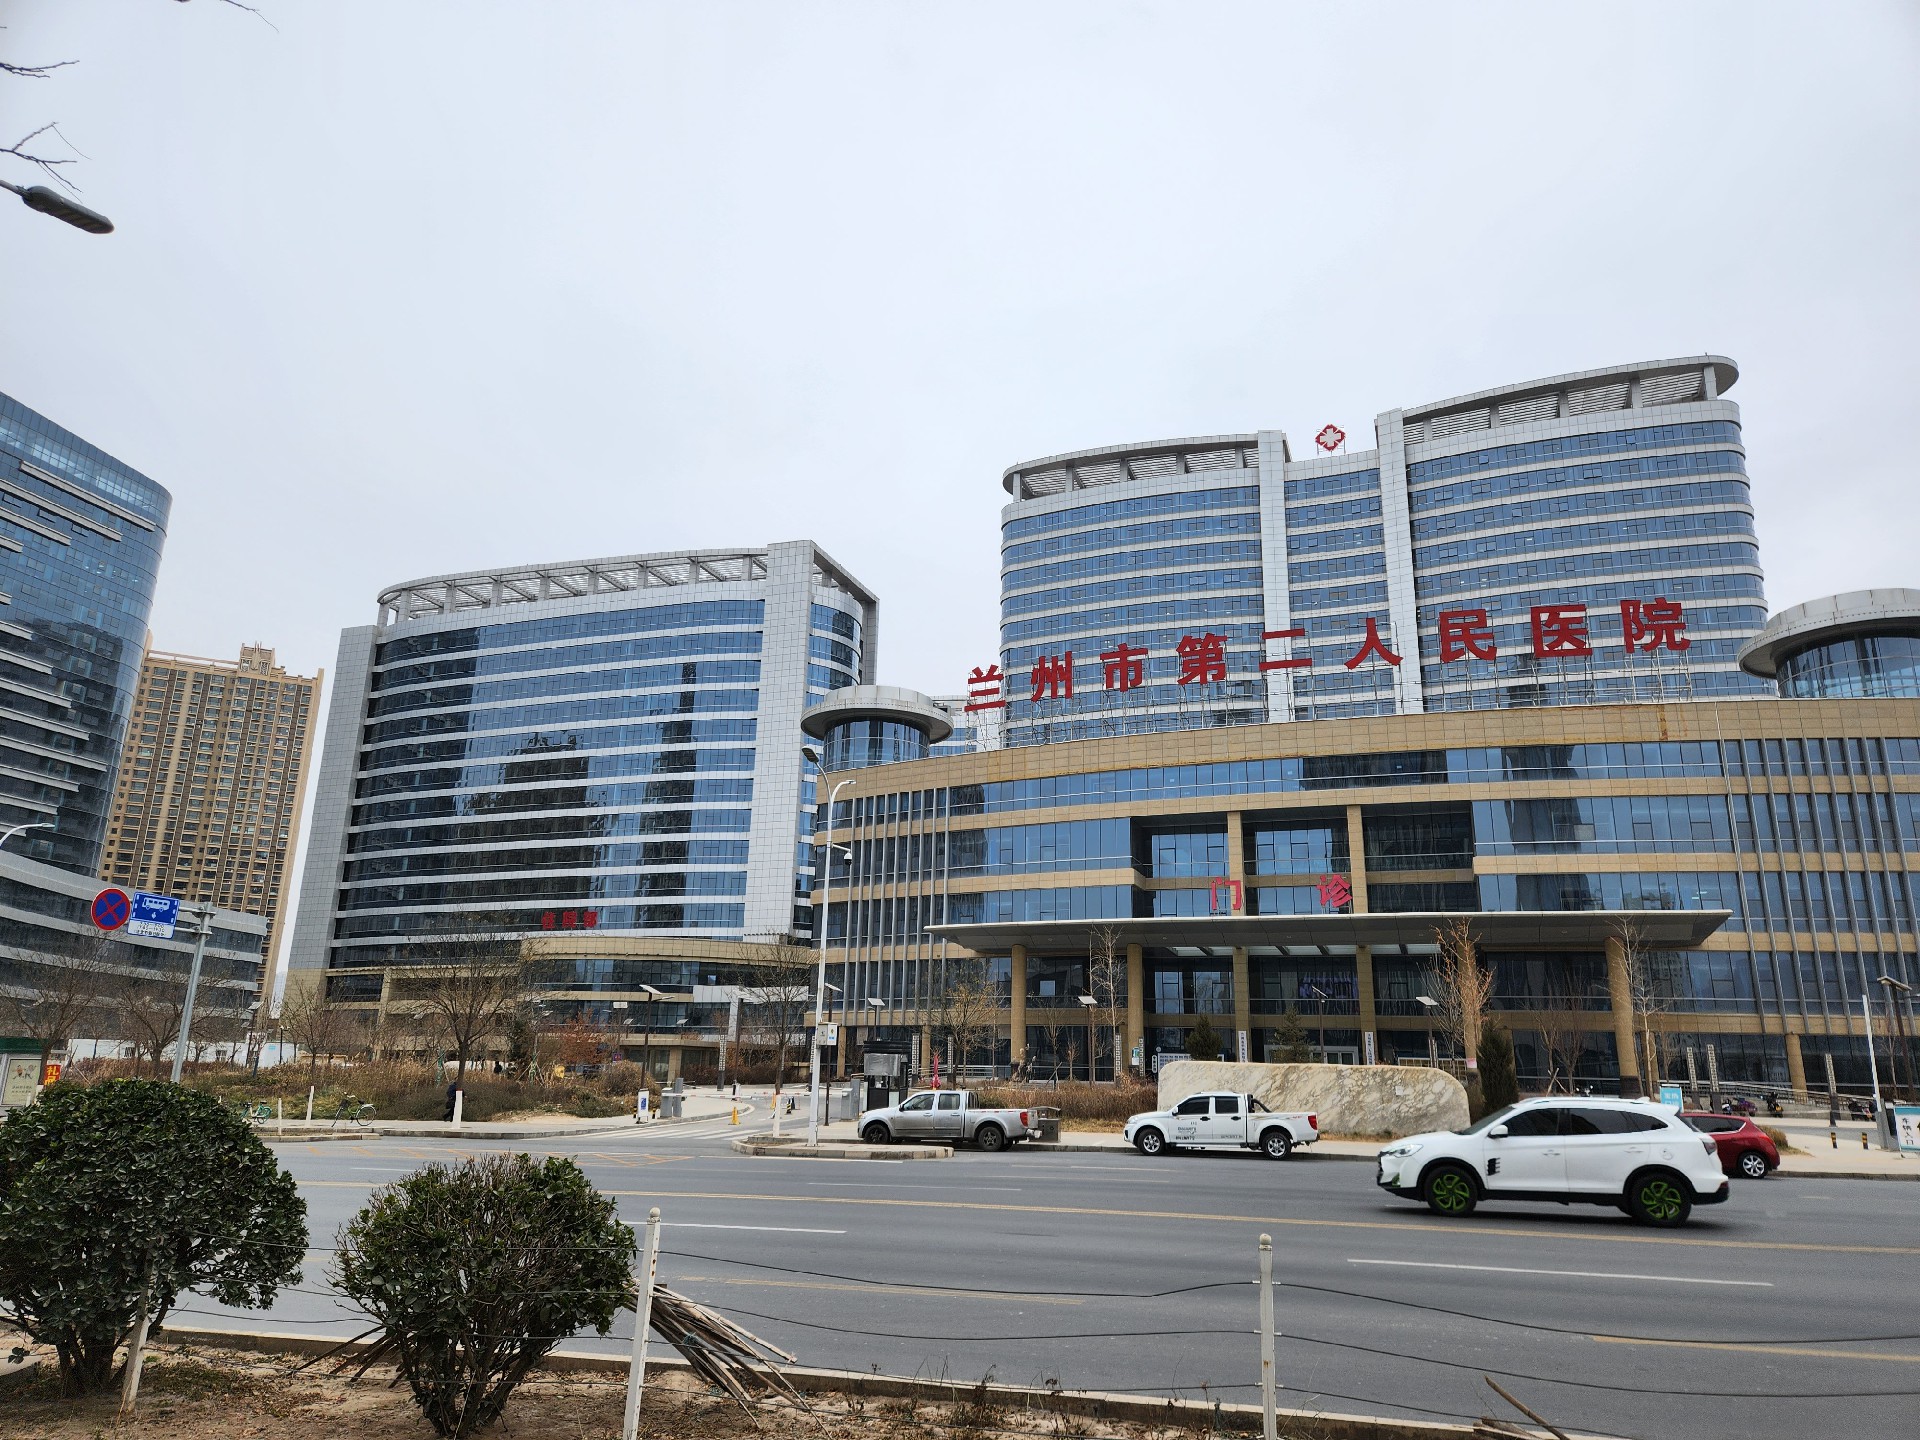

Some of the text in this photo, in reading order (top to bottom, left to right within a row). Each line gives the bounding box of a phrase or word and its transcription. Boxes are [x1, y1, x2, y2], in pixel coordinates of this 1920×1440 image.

[964, 597, 1692, 713] 兰州市第二人民医院
[1210, 874, 1353, 911] 门诊
[541, 911, 598, 929] 住院部
